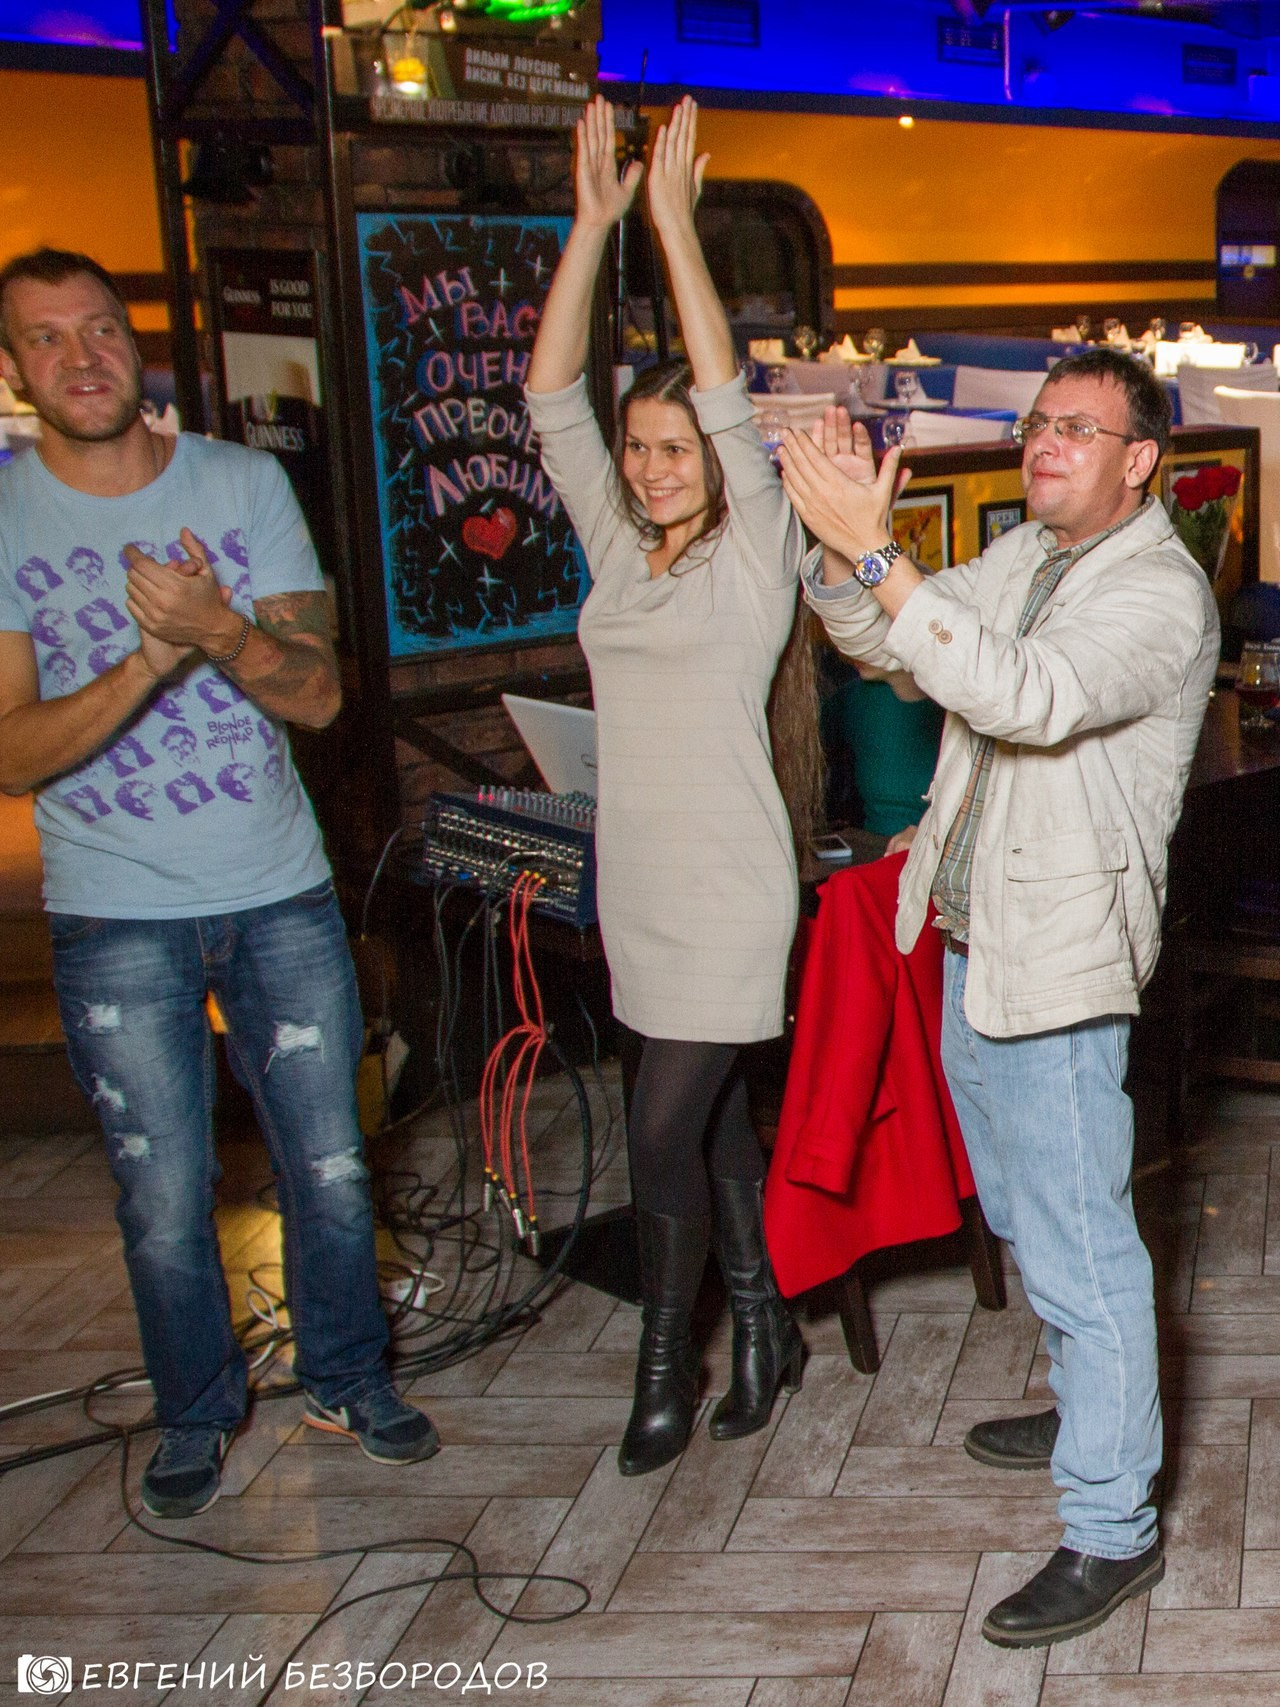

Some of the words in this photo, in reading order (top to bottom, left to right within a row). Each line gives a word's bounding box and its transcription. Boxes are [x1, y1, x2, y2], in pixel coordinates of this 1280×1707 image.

[507, 72, 527, 90] БЕЗ
[280, 279, 310, 297] GOOD
[397, 266, 478, 325] МЫ
[271, 301, 291, 317] FOR
[457, 301, 538, 340] ВАС
[420, 350, 531, 393] ОЧЕН
[245, 421, 304, 450] GUINNESS
[413, 397, 543, 454] ПРЕОЧЕ
[207, 713, 252, 735] BLONDE
[205, 727, 254, 756] REDHEAD
